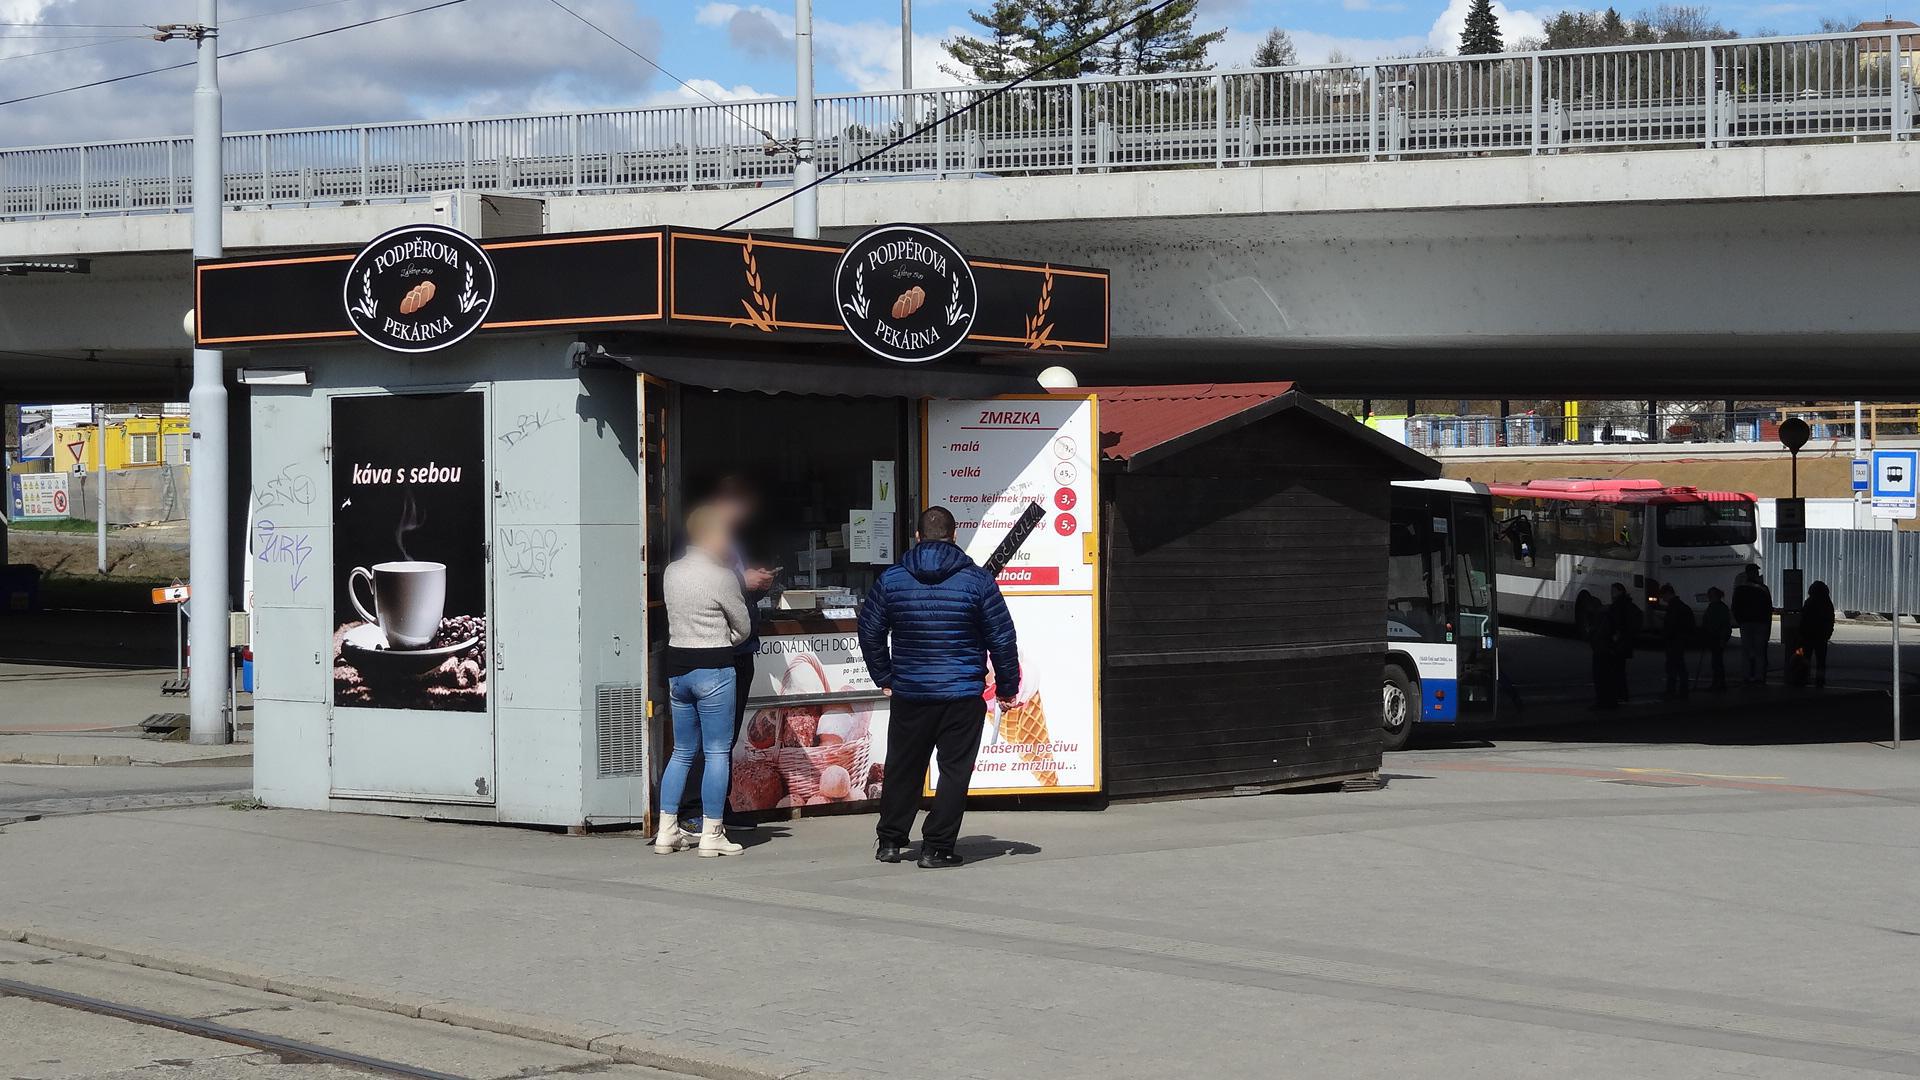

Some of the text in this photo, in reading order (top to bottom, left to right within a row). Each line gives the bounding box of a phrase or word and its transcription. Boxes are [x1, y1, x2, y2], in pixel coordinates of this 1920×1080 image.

[374, 236, 458, 274] PODPĚROVA
[867, 237, 946, 278] PODPĚROVA
[383, 316, 454, 342] PEKÁRNA
[874, 319, 941, 350] PEKÁRNA
[979, 411, 1041, 425] ZMRZKA
[950, 440, 980, 452] malá
[352, 461, 462, 484] káva s sebou
[950, 466, 981, 478] velká
[949, 494, 979, 503] termo
[981, 493, 1020, 503] kelímek
[1021, 493, 1046, 505] malý
[1061, 494, 1075, 505] 3,-
[954, 520, 979, 529] ermo
[1061, 520, 1075, 531] 5,-
[995, 569, 1032, 581] ahoda
[753, 636, 829, 657] GIONÁLNÍCH
[982, 740, 1078, 755] našemu pečivu
[972, 760, 1007, 772] číme
